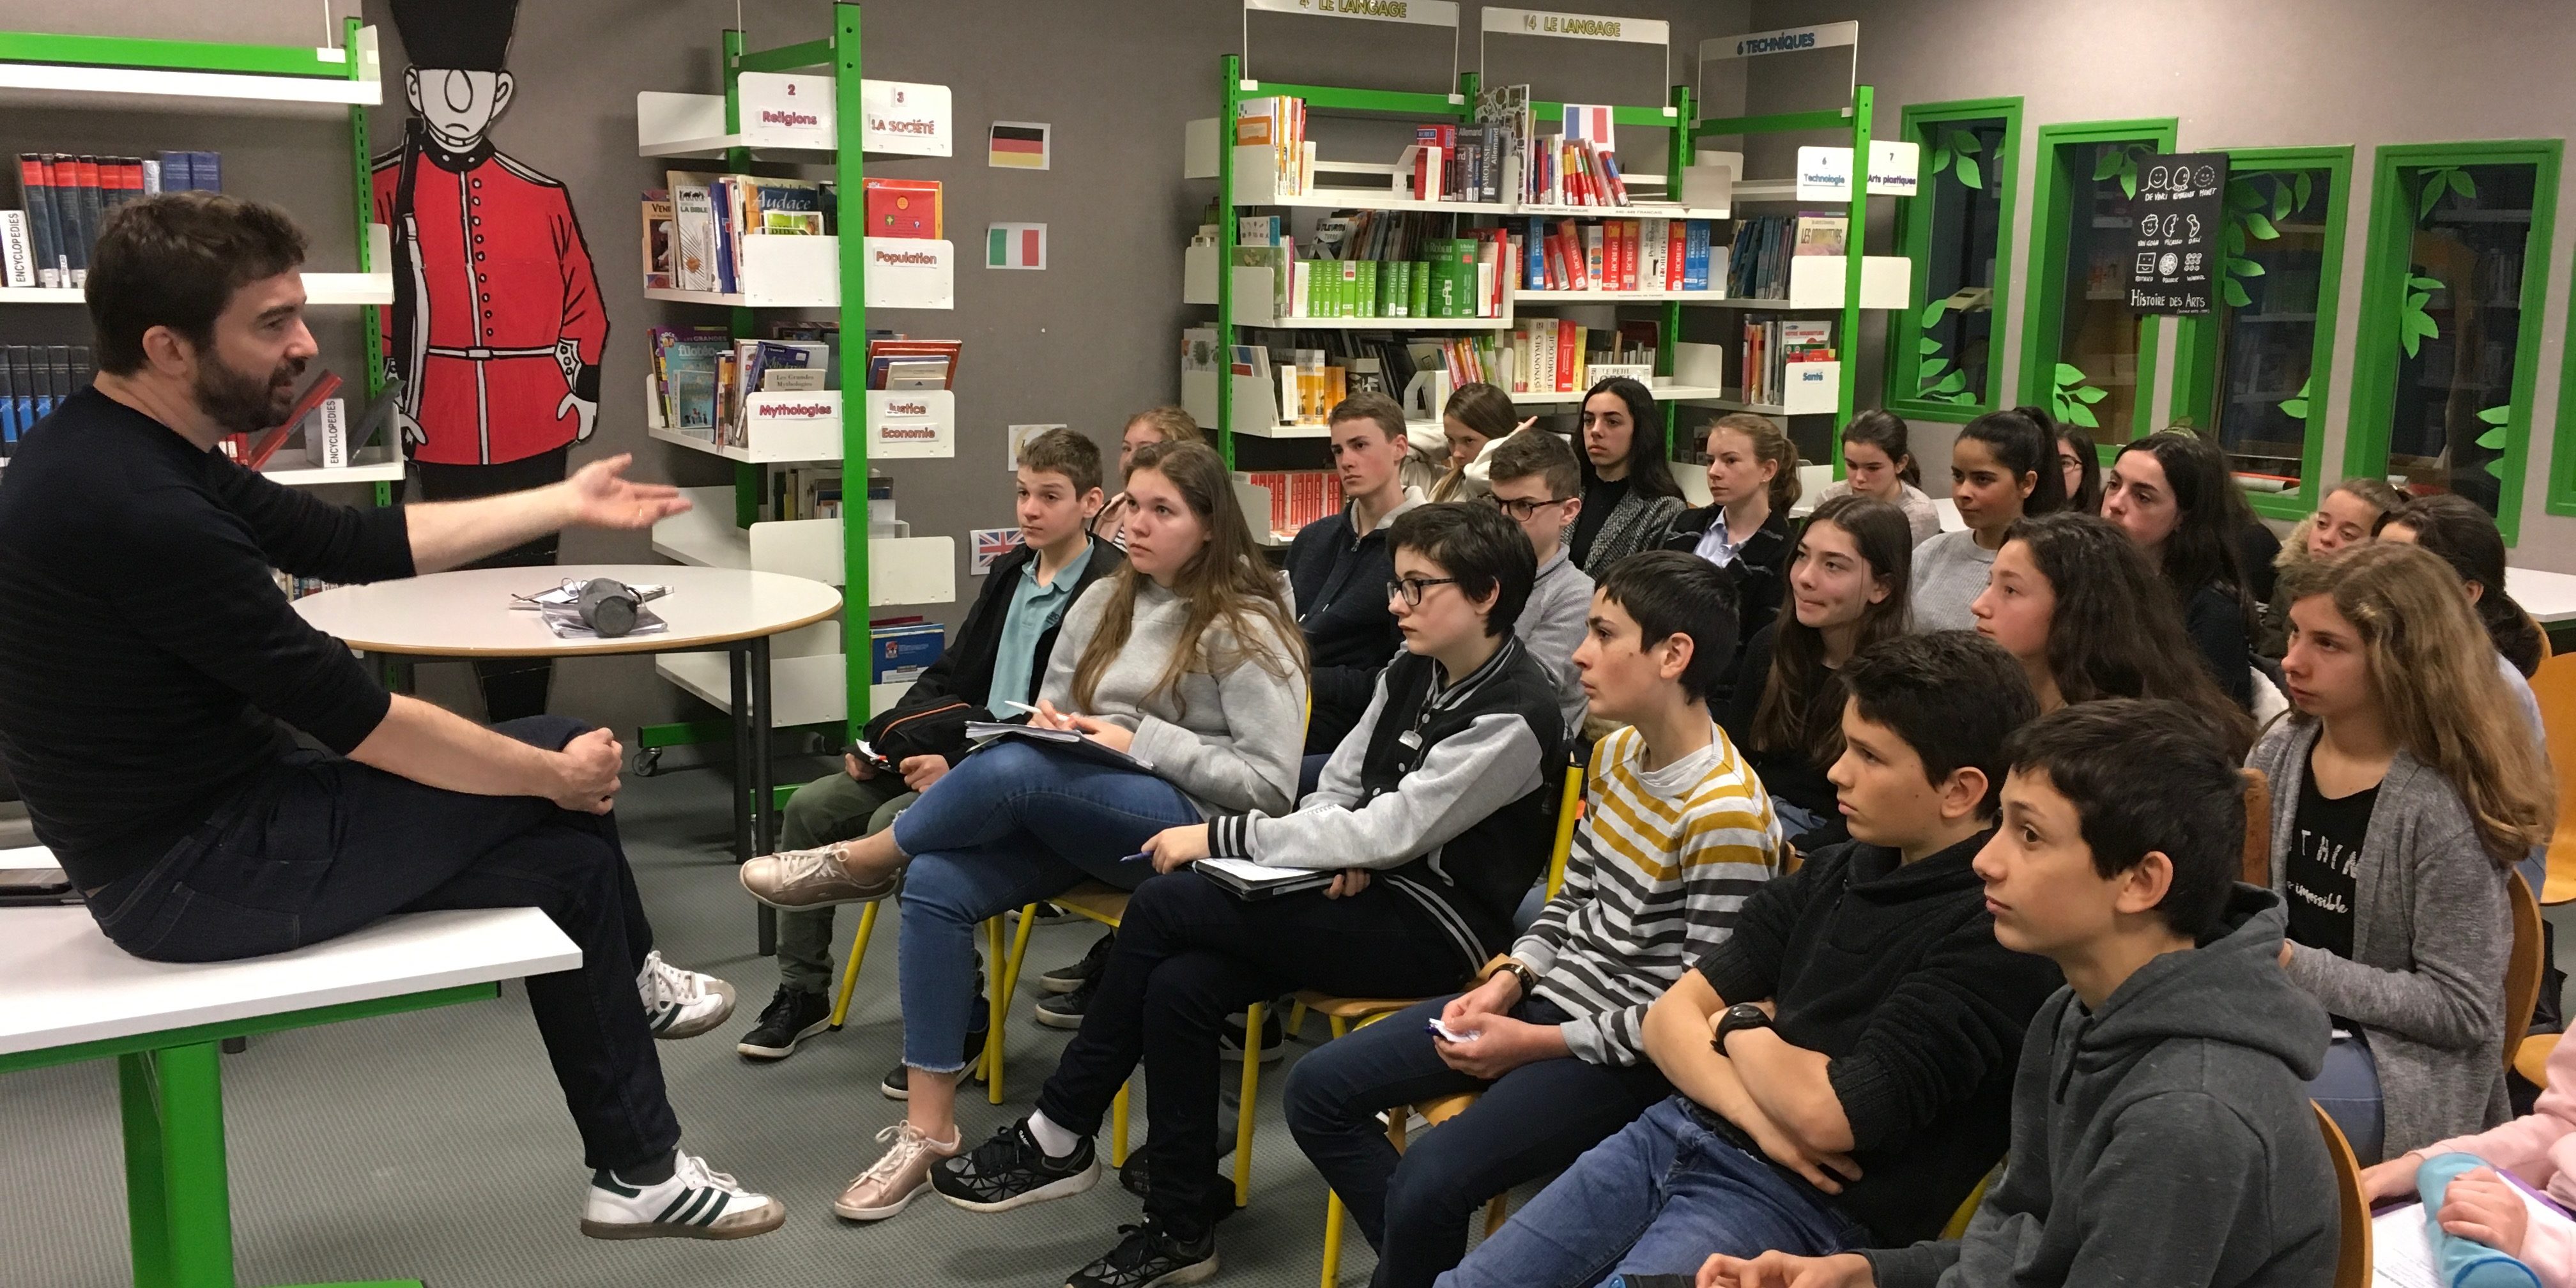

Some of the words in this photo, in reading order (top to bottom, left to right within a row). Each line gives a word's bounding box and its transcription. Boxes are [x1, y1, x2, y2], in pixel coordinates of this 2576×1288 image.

[1319, 0, 1334, 12] LE
[1338, 0, 1407, 18] LANGAGE
[1528, 15, 1537, 31] 4
[1544, 16, 1558, 32] LE
[1560, 17, 1621, 37] LANGAGE
[1736, 41, 1744, 56] 6
[1746, 31, 1815, 54] TECHNIQUES
[787, 84, 796, 96] 2
[896, 91, 905, 103] 3
[762, 111, 818, 126] Religions
[871, 119, 886, 132] LA
[889, 118, 935, 135] SOCIÉTÉ
[1491, 128, 1499, 165] Allemand
[1821, 157, 1827, 166] 6
[1889, 153, 1894, 162] 7
[1482, 145, 1491, 194] AROUSSE
[1804, 172, 1846, 186] Technologie
[1867, 174, 1882, 184] Arts
[1883, 174, 1917, 186] plastiques
[751, 190, 811, 210] Audace
[2145, 192, 2154, 201] DE
[2154, 191, 2168, 201] VINCI
[2199, 187, 2218, 198] MONET
[8, 212, 26, 283] ENCYCLOPEDIES
[876, 250, 938, 266] Population
[1534, 335, 1542, 388] SYNONYMES
[1803, 372, 1823, 381] Santé
[758, 403, 832, 418] Mythologies
[887, 402, 926, 415] Justice
[326, 401, 339, 464] ENCYCLOPEDIES
[881, 427, 935, 439] Economie
